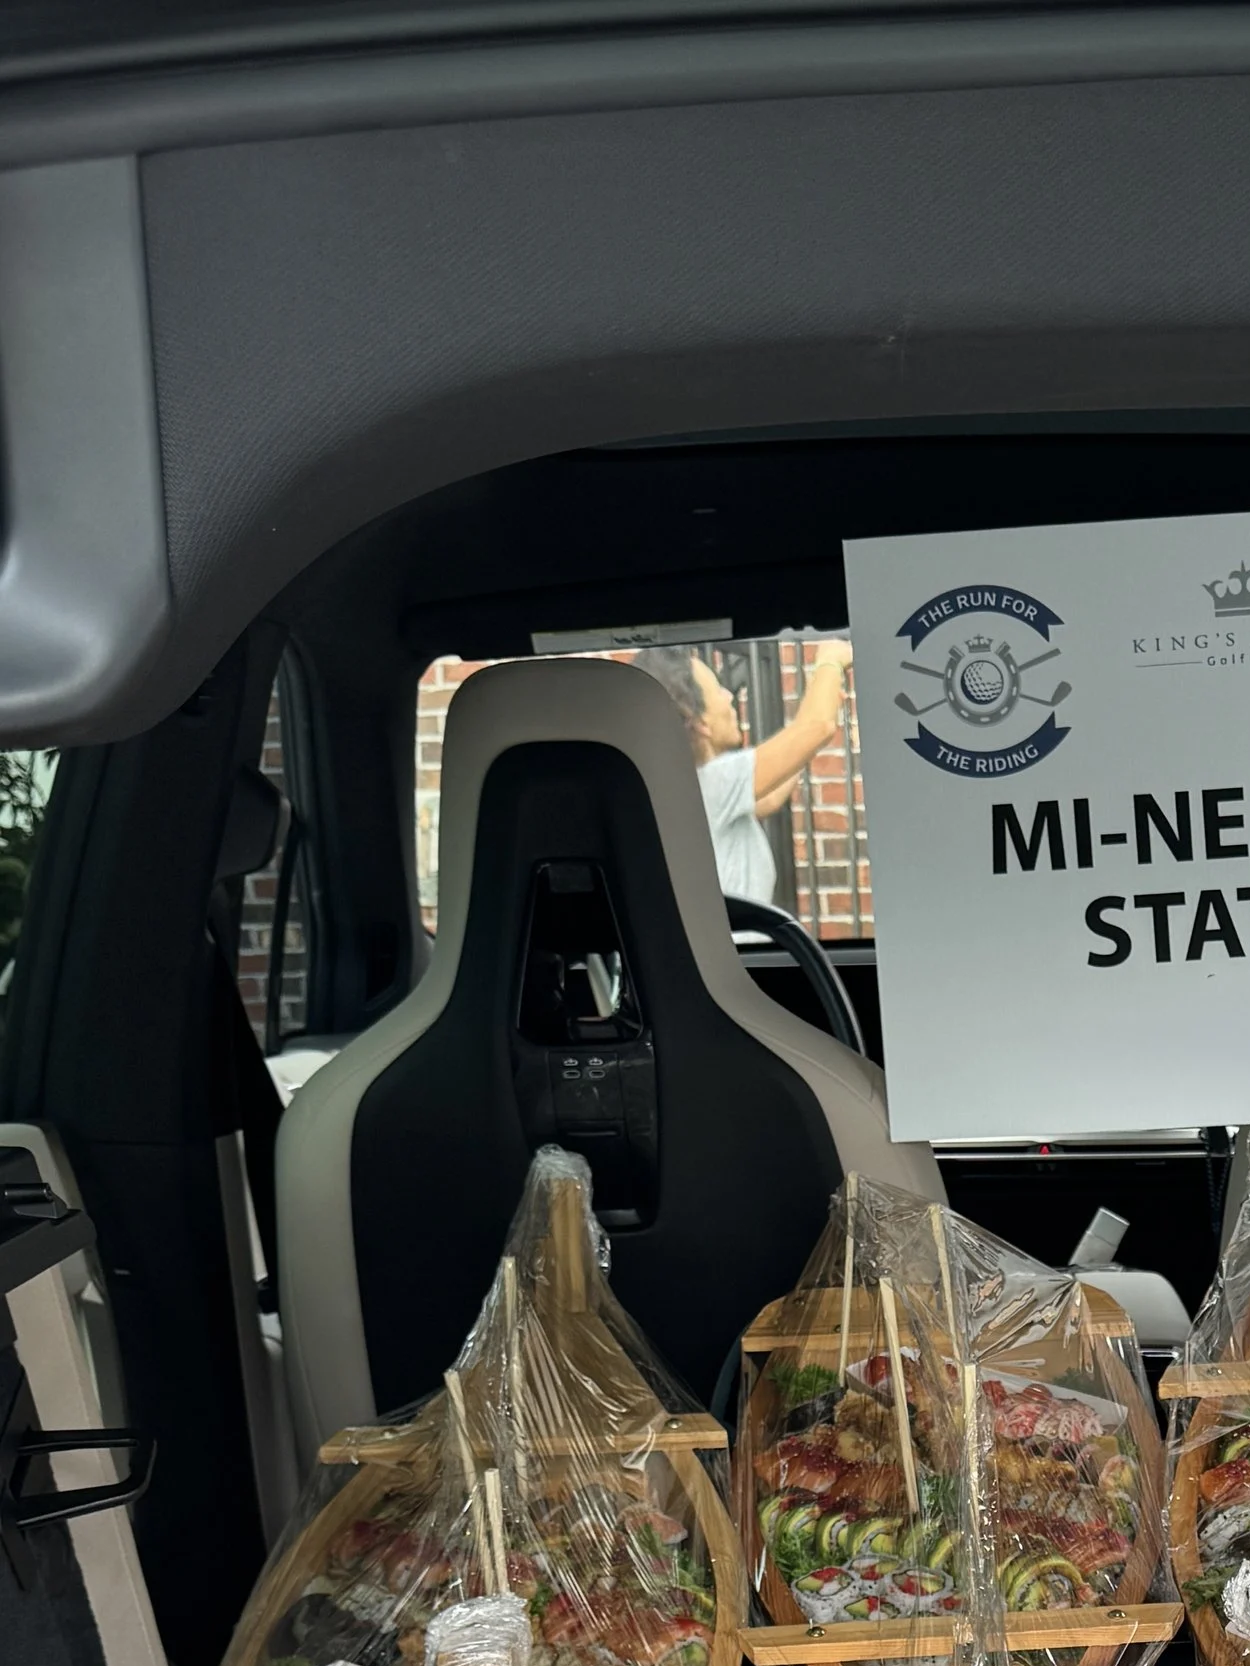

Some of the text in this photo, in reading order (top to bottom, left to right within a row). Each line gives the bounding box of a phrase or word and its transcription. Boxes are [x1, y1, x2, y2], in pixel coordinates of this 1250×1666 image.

[918, 592, 1038, 628] THE RUN FOR
[1132, 632, 1236, 654] KING'S
[1207, 653, 1245, 667] Golf
[936, 744, 1039, 773] THE RIDING
[991, 786, 1250, 875] MI-NE
